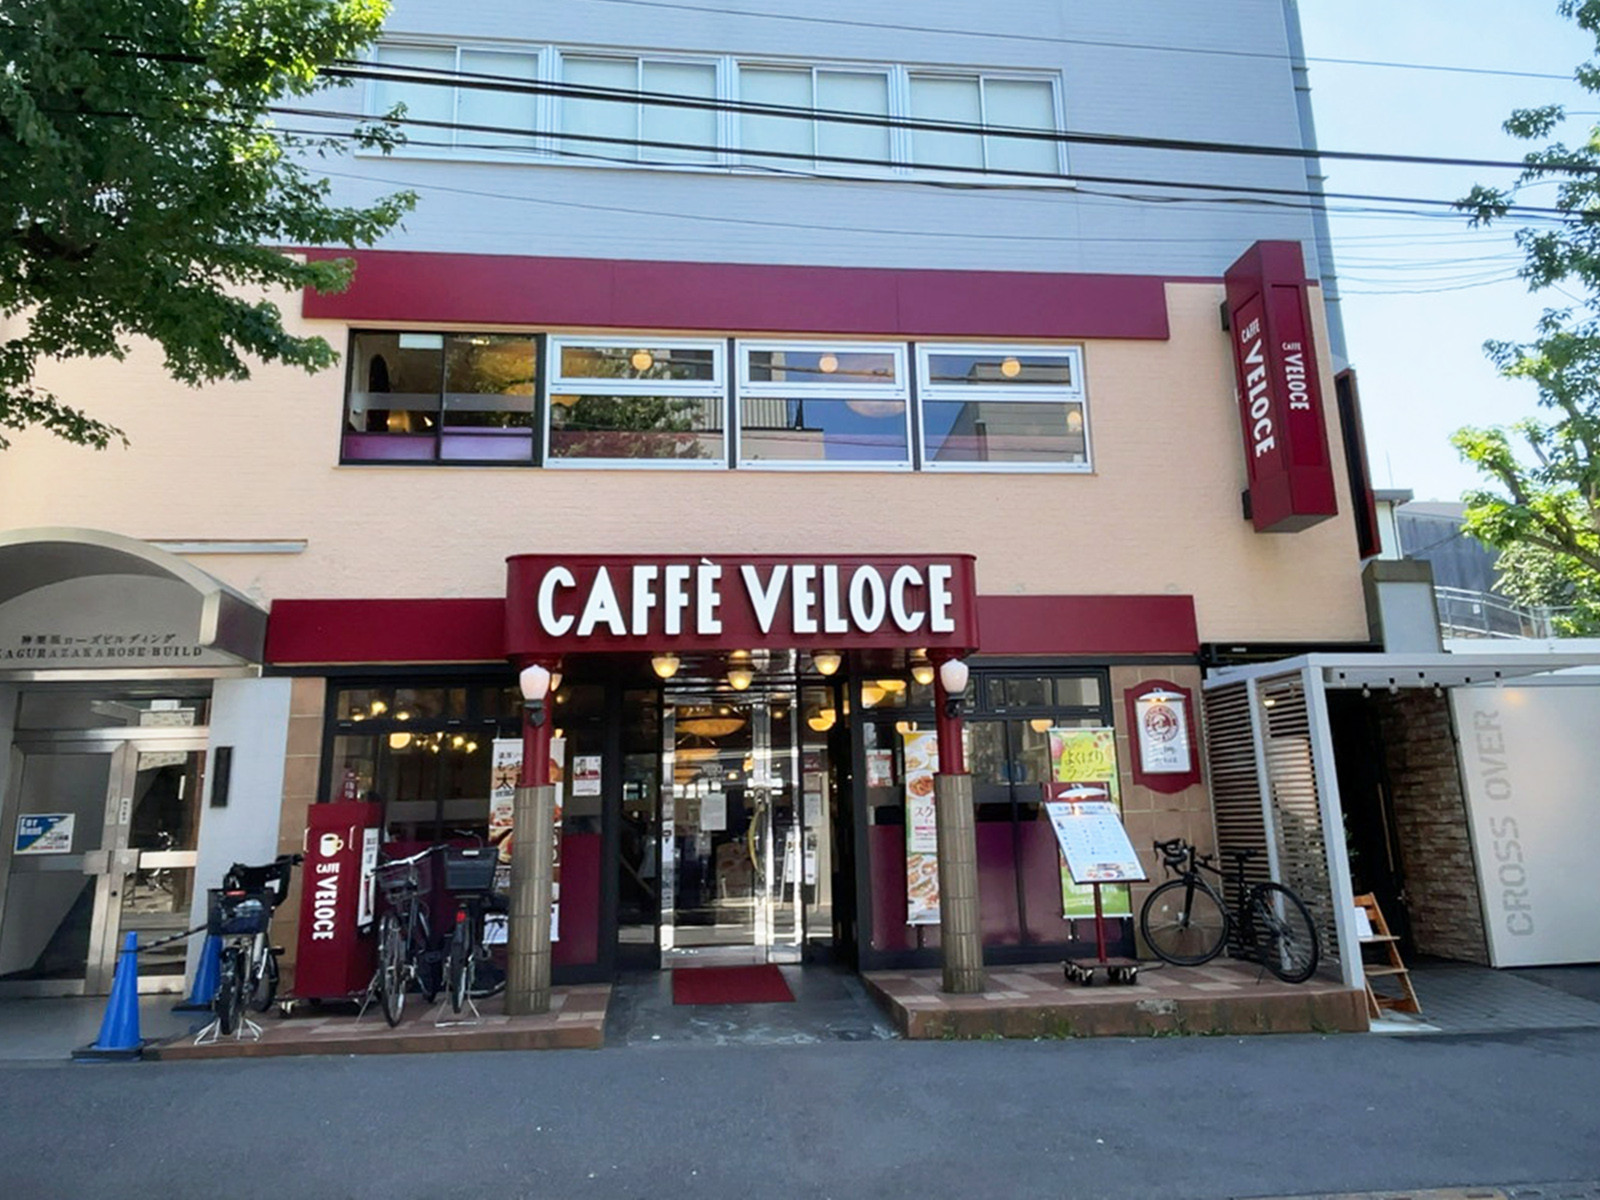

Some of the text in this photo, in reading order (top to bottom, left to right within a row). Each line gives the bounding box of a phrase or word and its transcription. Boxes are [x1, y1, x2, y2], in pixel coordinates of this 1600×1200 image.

[1245, 338, 1275, 458] VELOCE
[1284, 353, 1310, 410] VELOCE
[538, 558, 955, 637] CAFFÈ VELOCE
[1473, 709, 1535, 937] CROSS OVER
[312, 875, 339, 940] VELOCE
